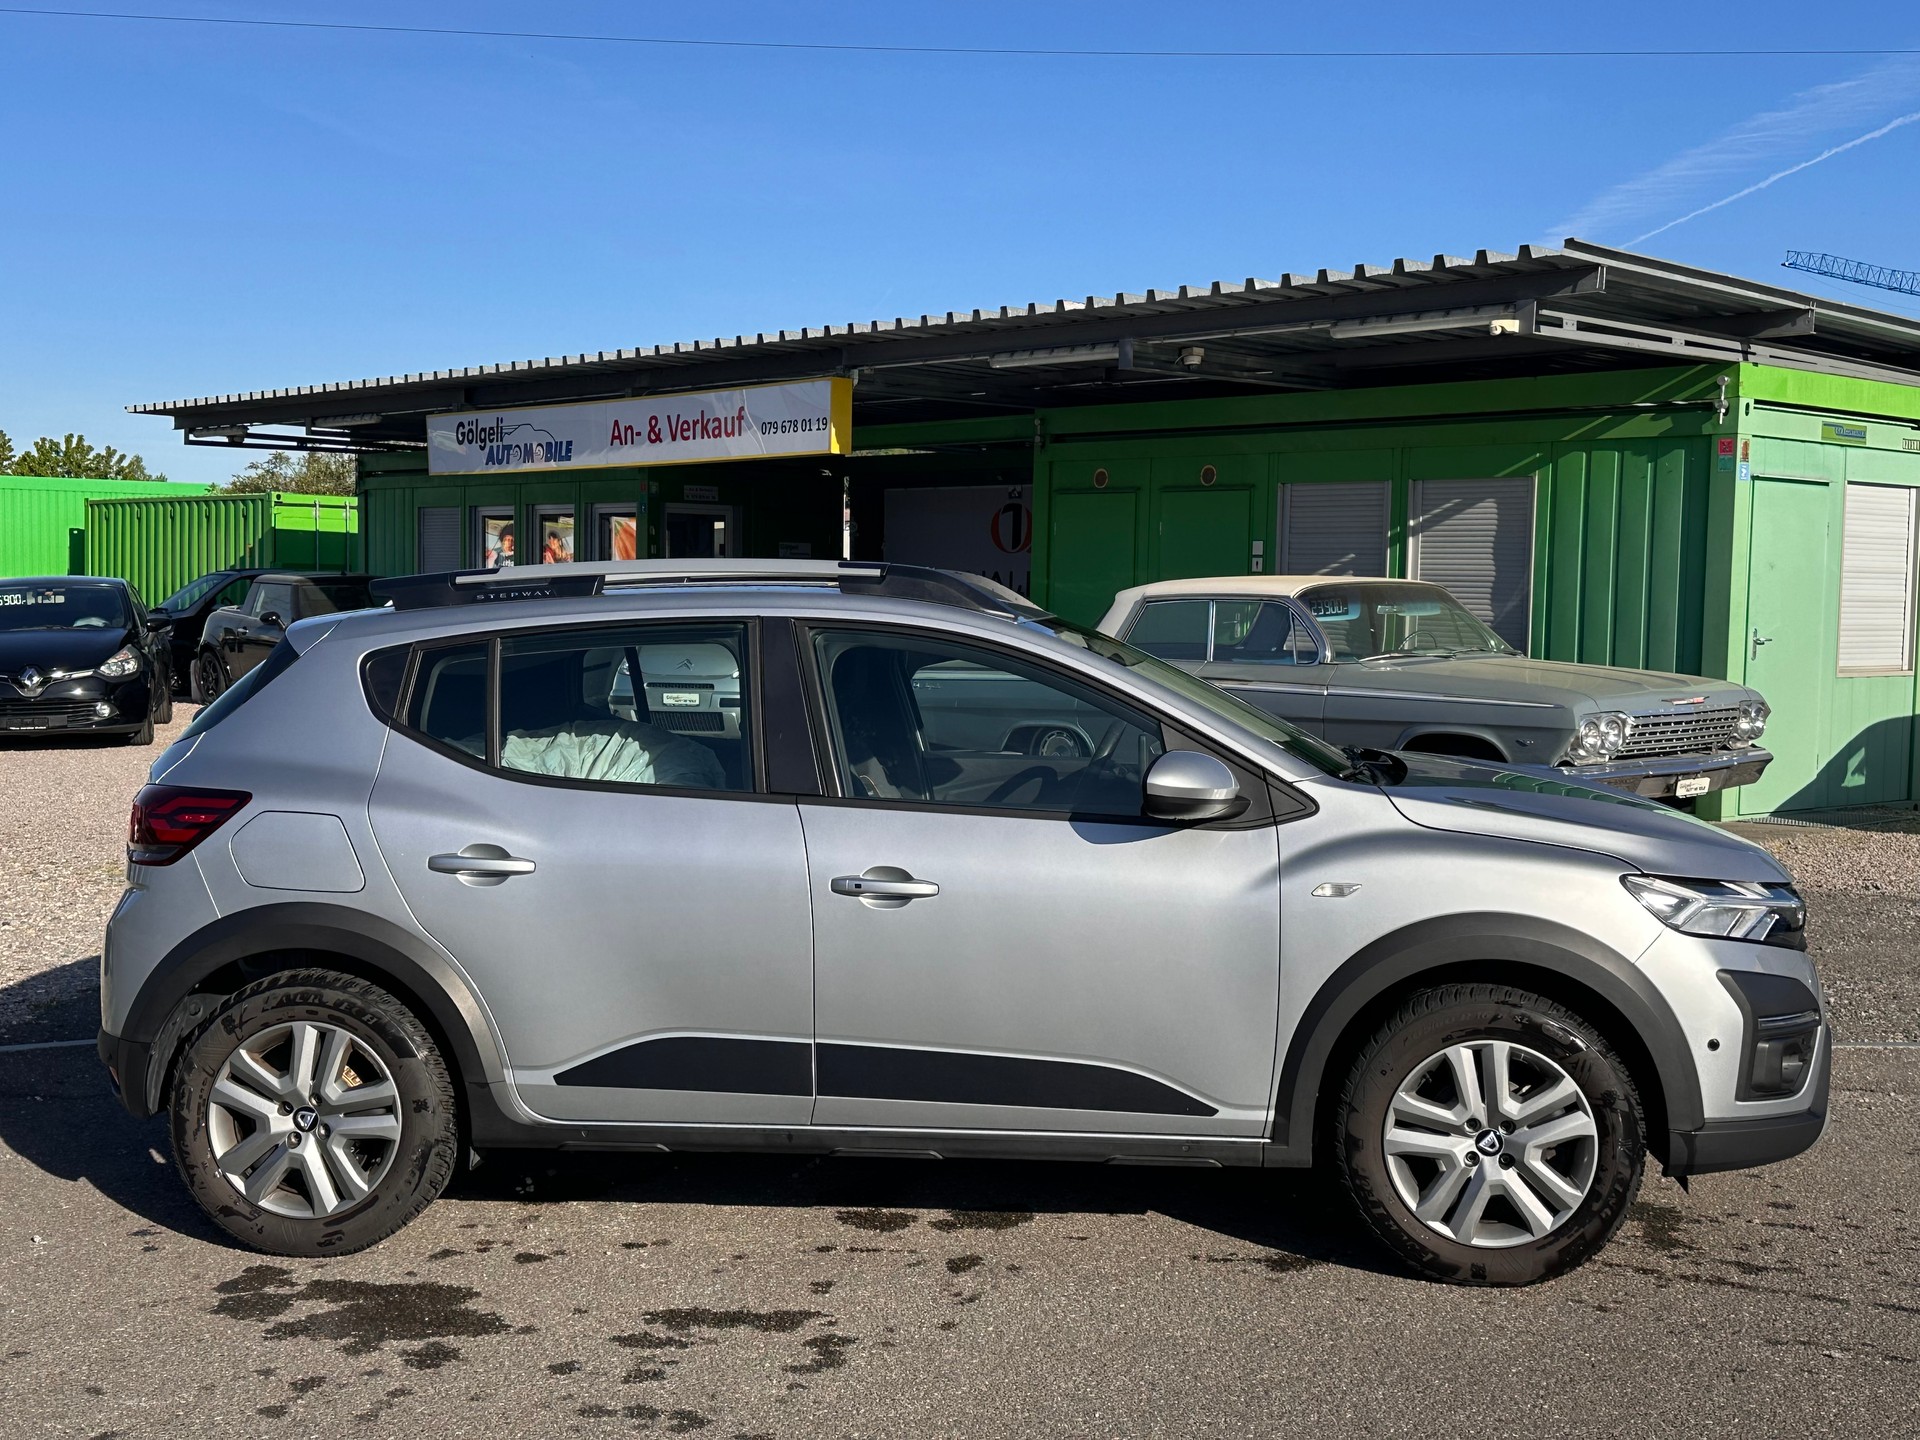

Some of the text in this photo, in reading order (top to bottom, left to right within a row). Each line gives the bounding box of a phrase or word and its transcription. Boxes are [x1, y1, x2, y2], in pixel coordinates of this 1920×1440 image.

[456, 417, 504, 451] Gölgeli
[610, 406, 745, 446] An- & Verkauf
[760, 417, 828, 435] 079 678 01 19
[485, 440, 573, 466] AUTOMOBILE
[476, 589, 552, 601] STEPWAY
